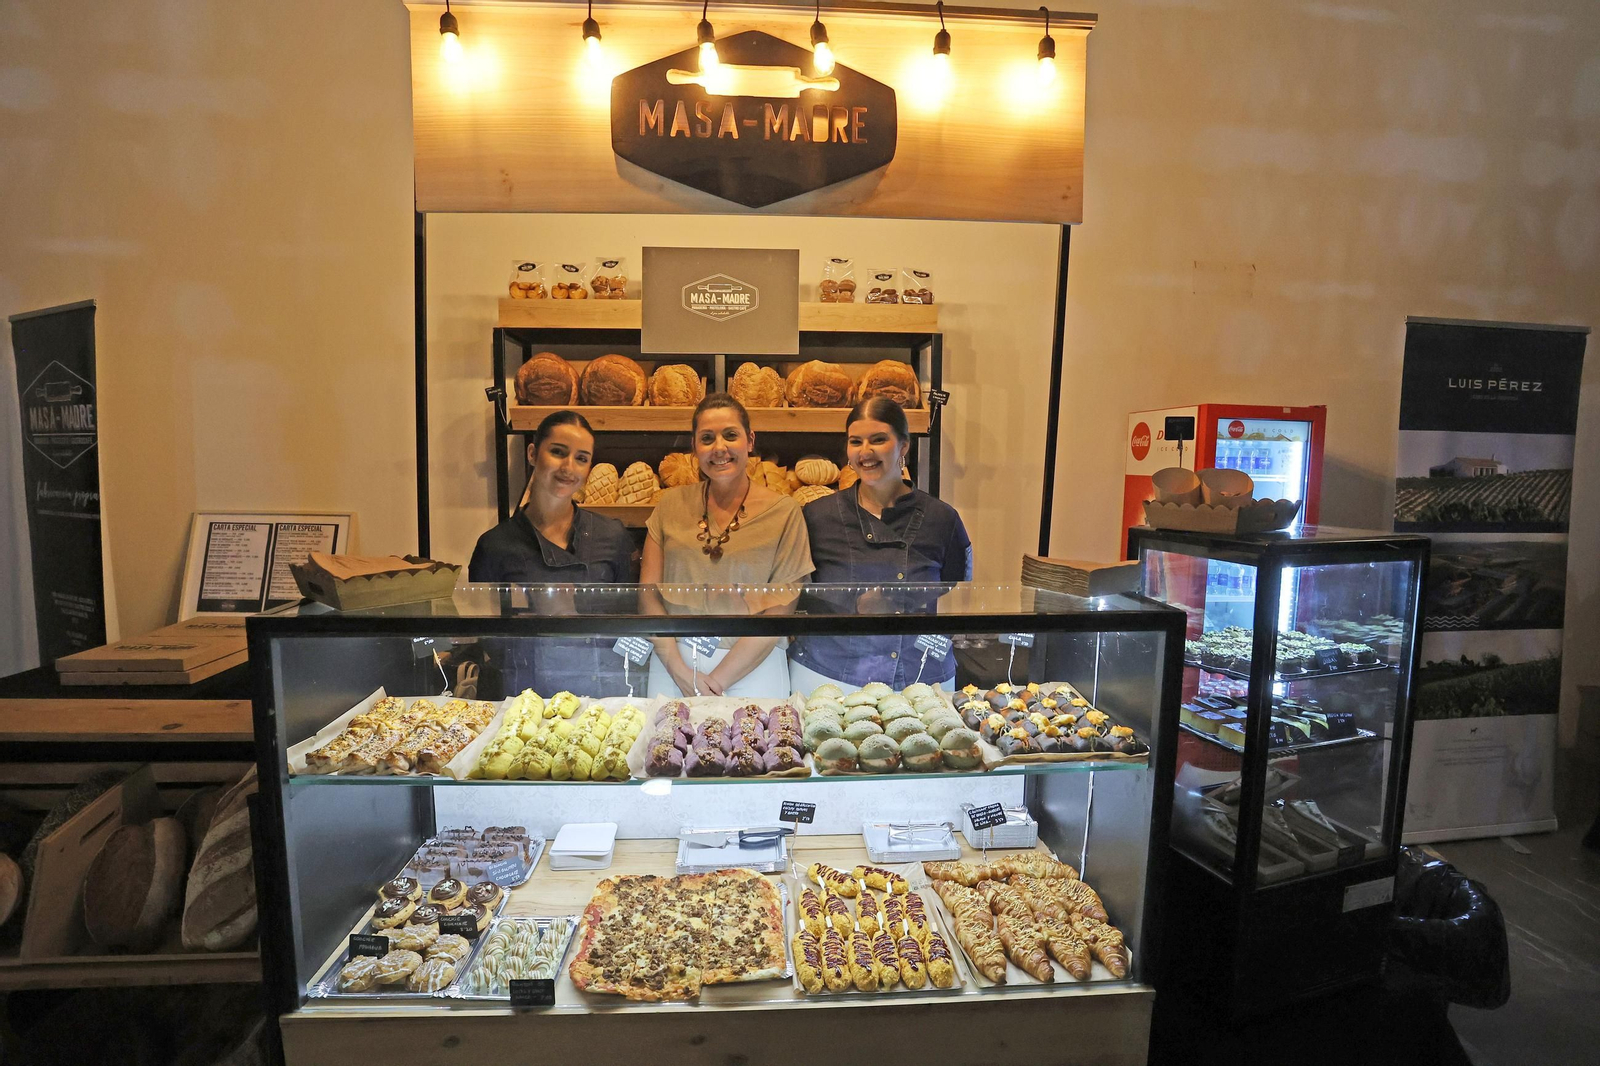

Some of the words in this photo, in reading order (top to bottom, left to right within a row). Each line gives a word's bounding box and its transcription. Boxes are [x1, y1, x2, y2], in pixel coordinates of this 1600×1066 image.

[1448, 378, 1483, 389] LUIS
[1488, 378, 1542, 392] PÉREZ
[232, 524, 257, 532] ESPECIAL
[279, 524, 297, 532] CARTA
